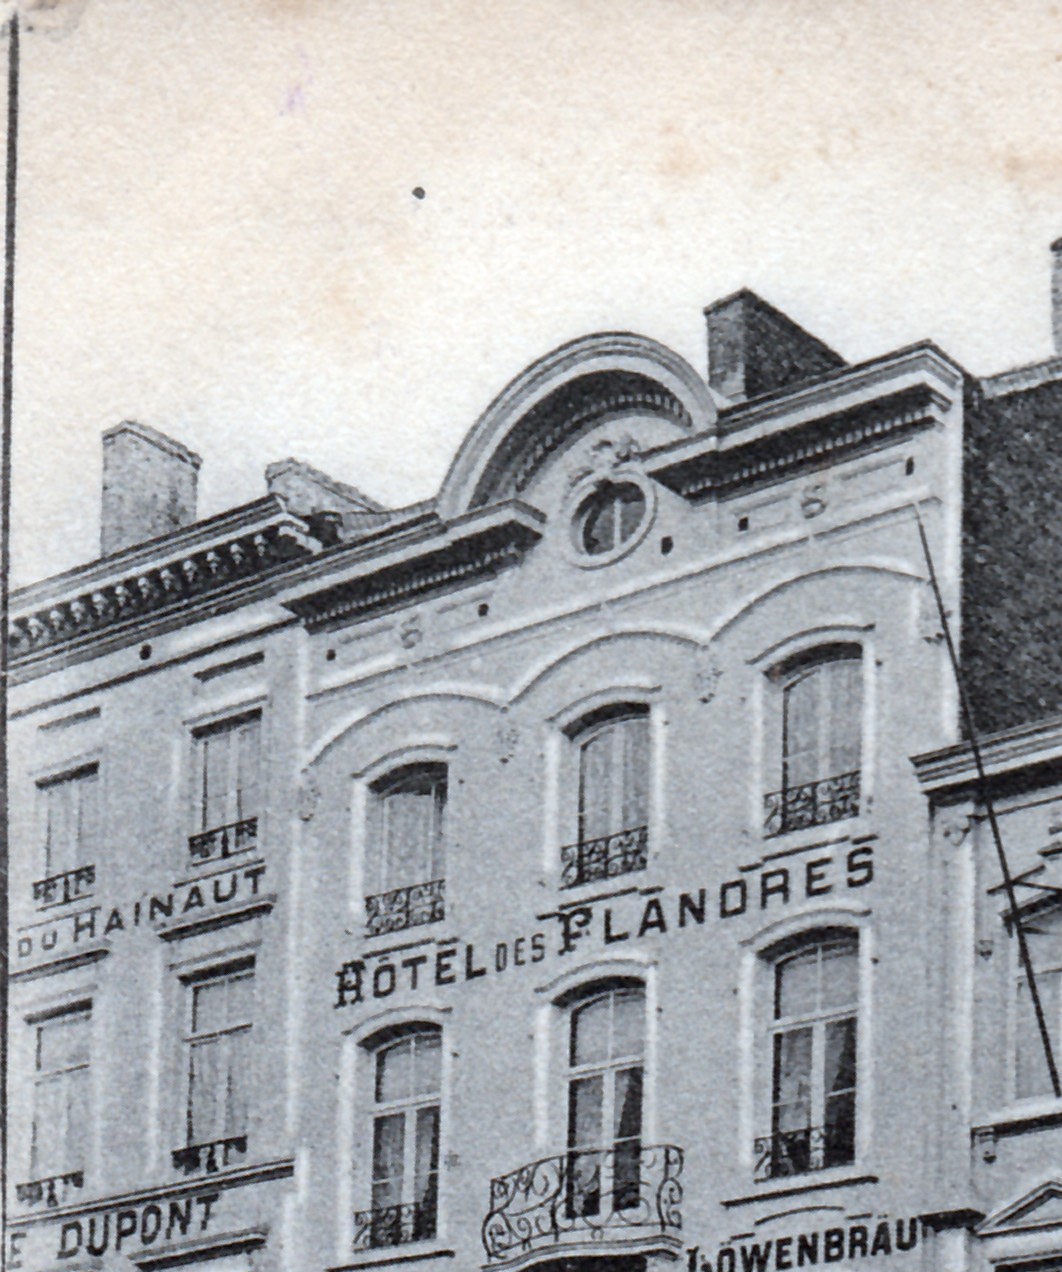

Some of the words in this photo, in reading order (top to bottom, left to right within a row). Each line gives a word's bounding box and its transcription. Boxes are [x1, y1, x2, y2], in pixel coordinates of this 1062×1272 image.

[495, 932, 546, 972] DES
[557, 846, 876, 956] FLANDRES
[17, 930, 57, 958] DU
[56, 1192, 220, 1260] DUPONT
